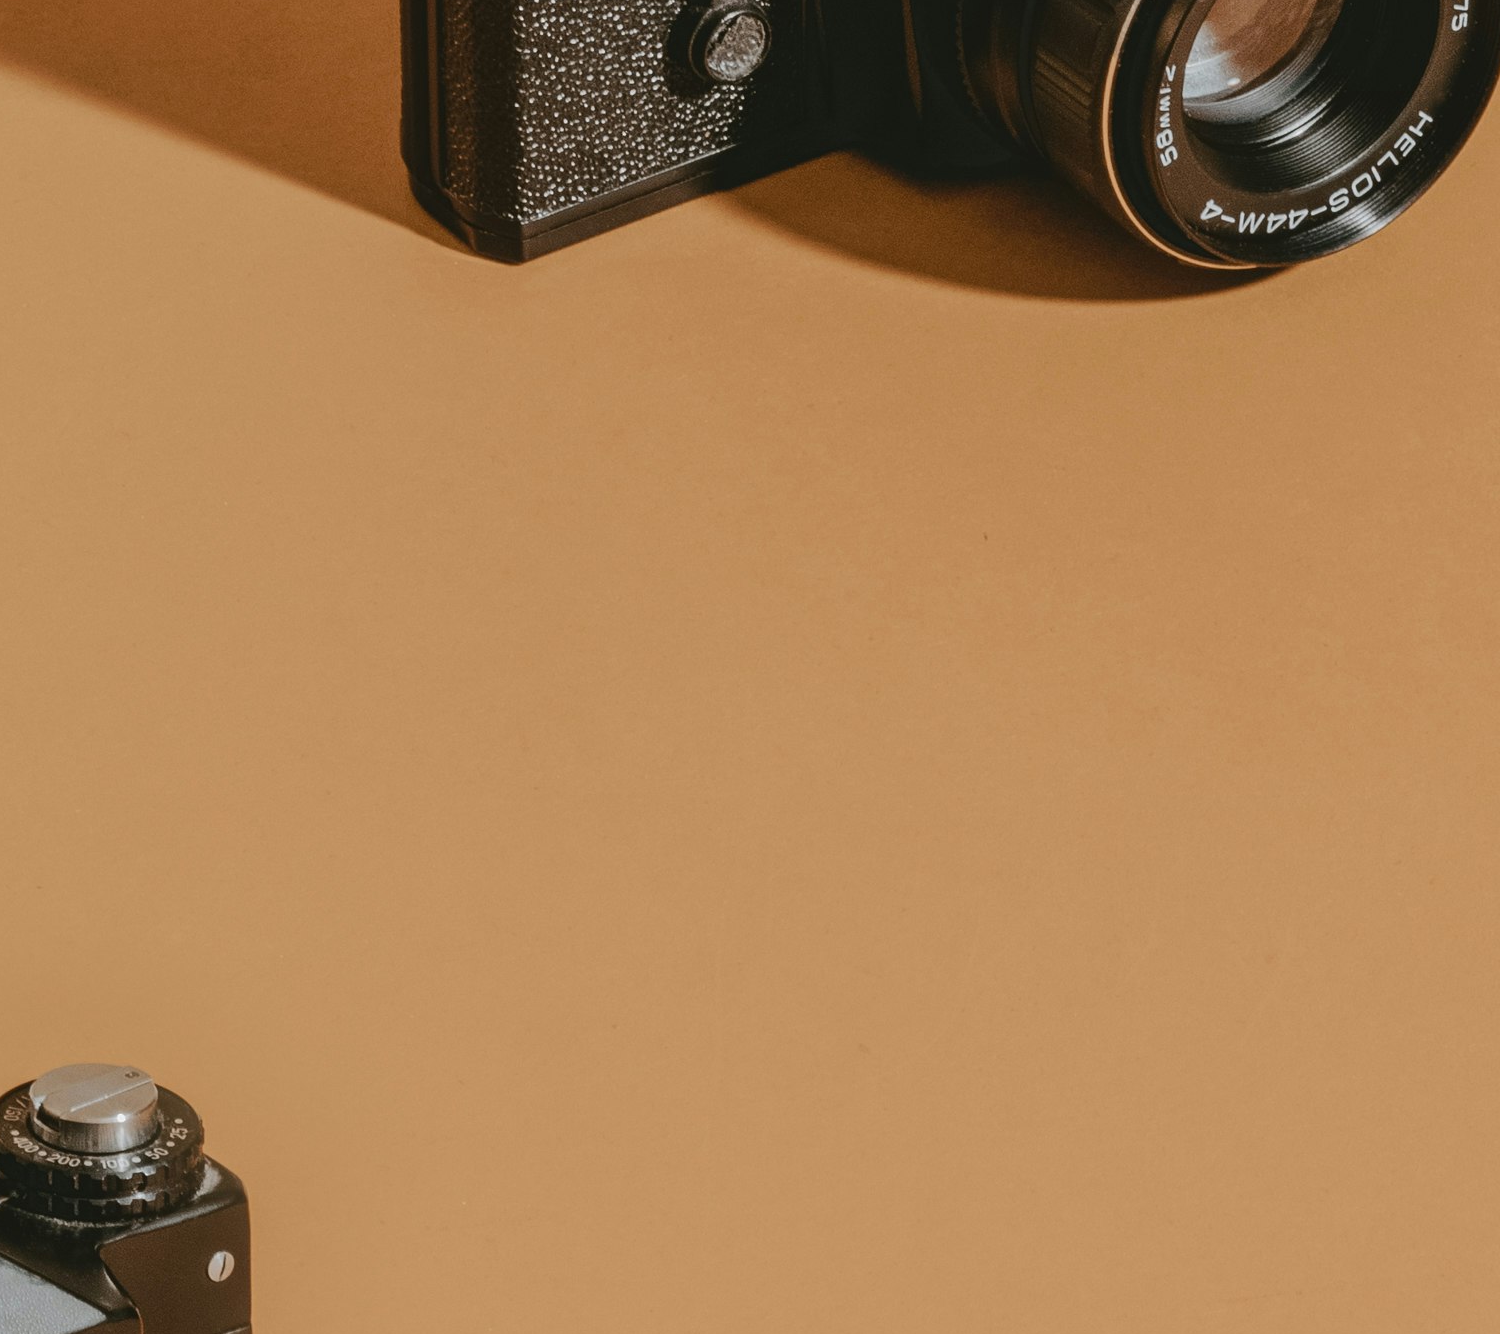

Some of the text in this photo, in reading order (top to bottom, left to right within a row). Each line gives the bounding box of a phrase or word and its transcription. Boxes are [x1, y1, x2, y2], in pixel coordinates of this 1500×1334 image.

[1200, 110, 1433, 234] HELIOS-44M-4
[14, 1136, 40, 1153] 400
[47, 1153, 81, 1167] 200
[144, 1147, 169, 1160] 50
[171, 1127, 189, 1140] 25
